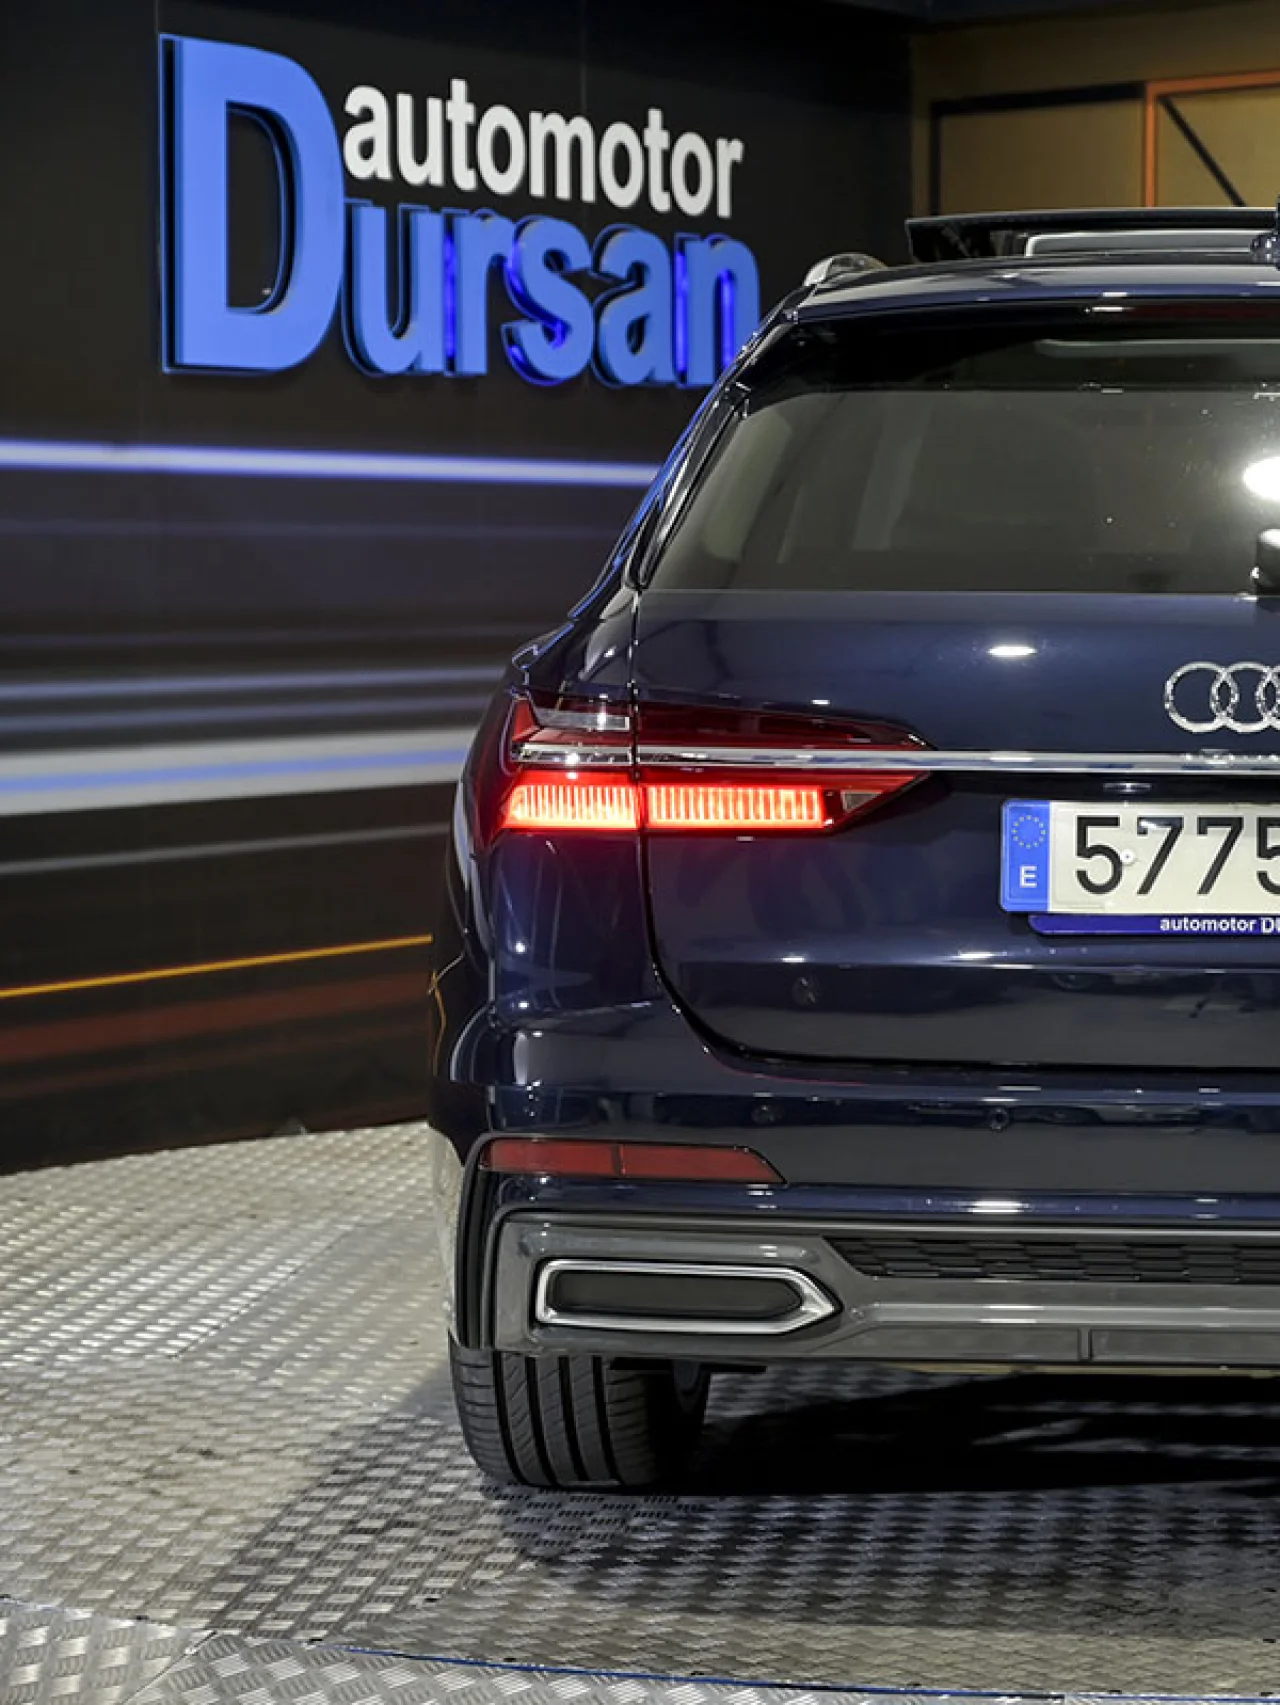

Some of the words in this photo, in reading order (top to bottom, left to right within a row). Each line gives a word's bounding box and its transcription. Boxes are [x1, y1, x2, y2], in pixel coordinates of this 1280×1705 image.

[343, 78, 744, 219] automotor
[159, 33, 762, 390] Dursan
[1019, 865, 1038, 888] E
[1160, 916, 1257, 932] automotor
